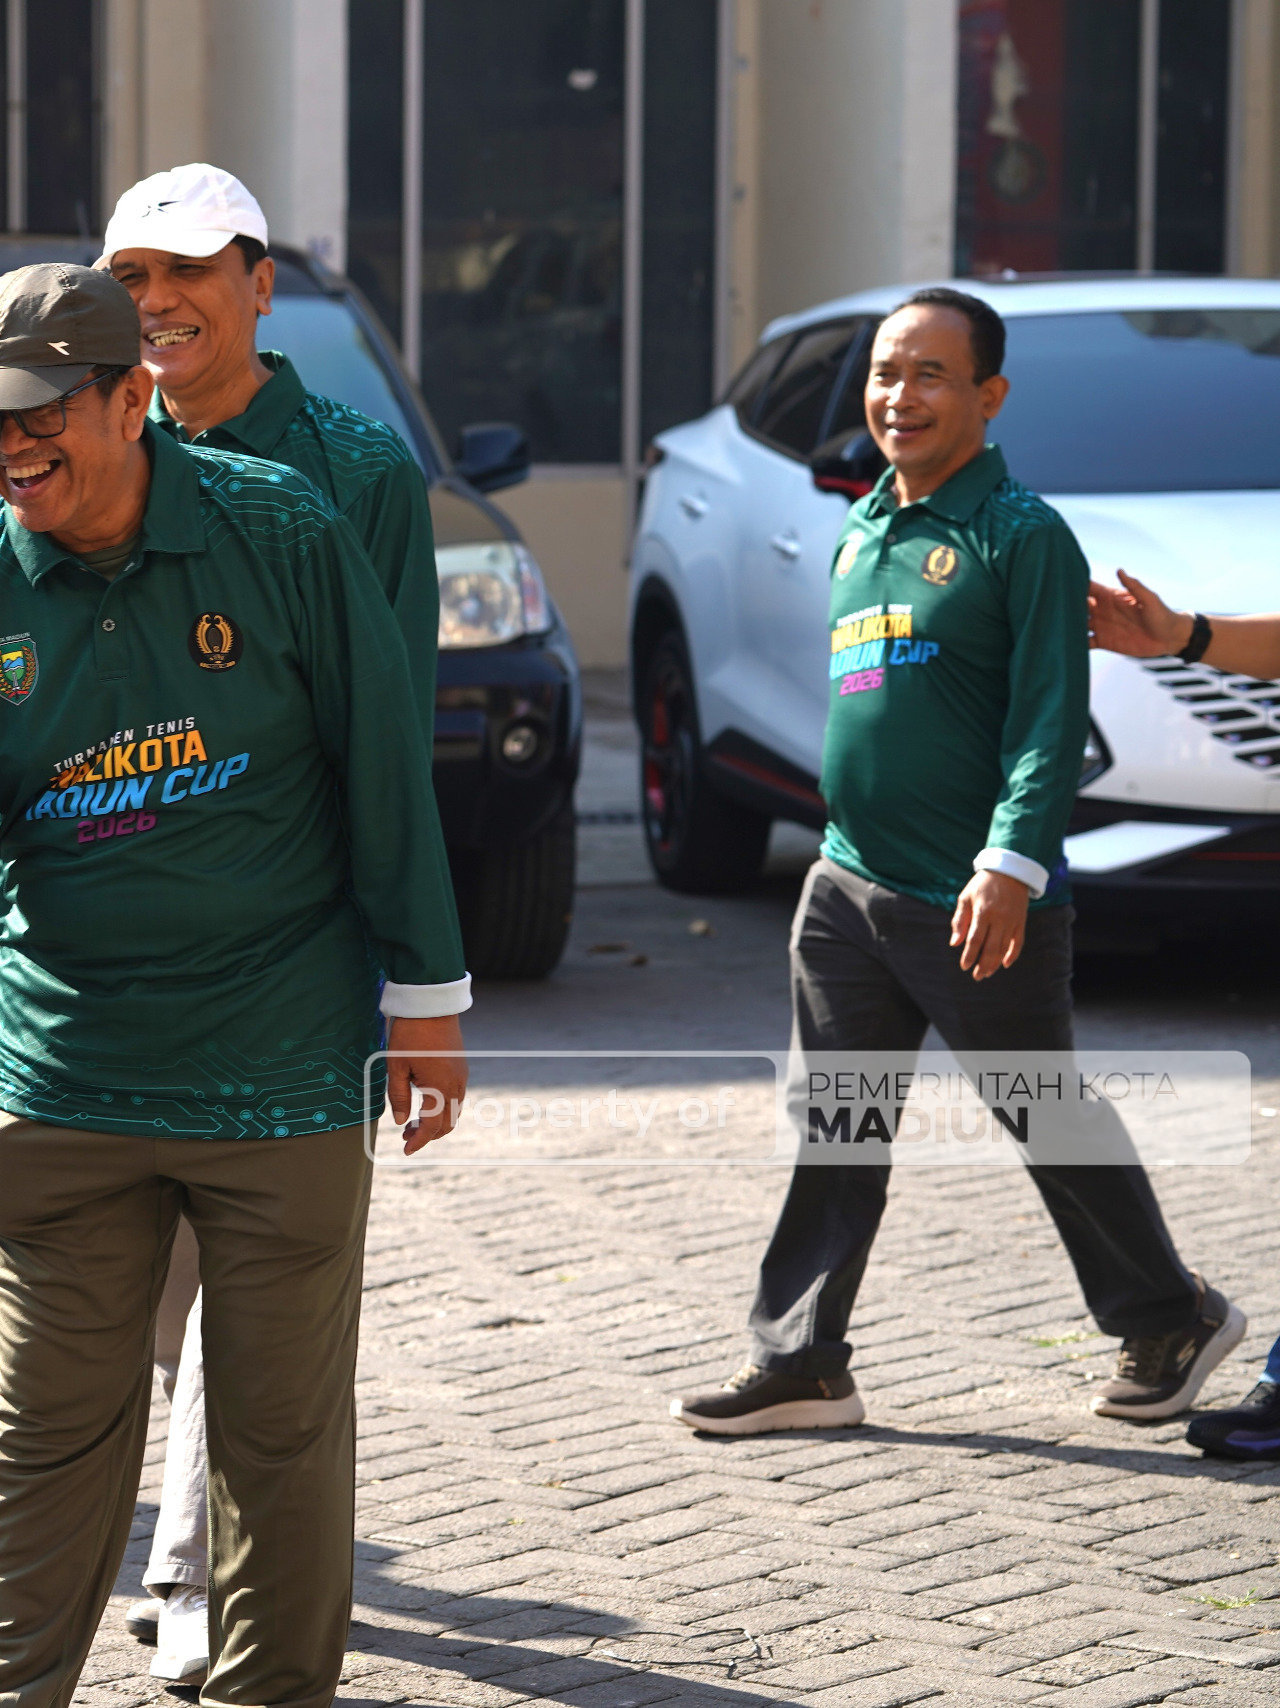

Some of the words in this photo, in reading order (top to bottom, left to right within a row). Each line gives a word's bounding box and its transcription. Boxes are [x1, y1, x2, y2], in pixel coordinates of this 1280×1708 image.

[888, 638, 940, 665] CUP
[839, 667, 885, 696] 2026
[147, 716, 195, 738] TENIS
[25, 776, 154, 821] ADIUN
[161, 753, 250, 804] CUP
[77, 810, 157, 843] 2026
